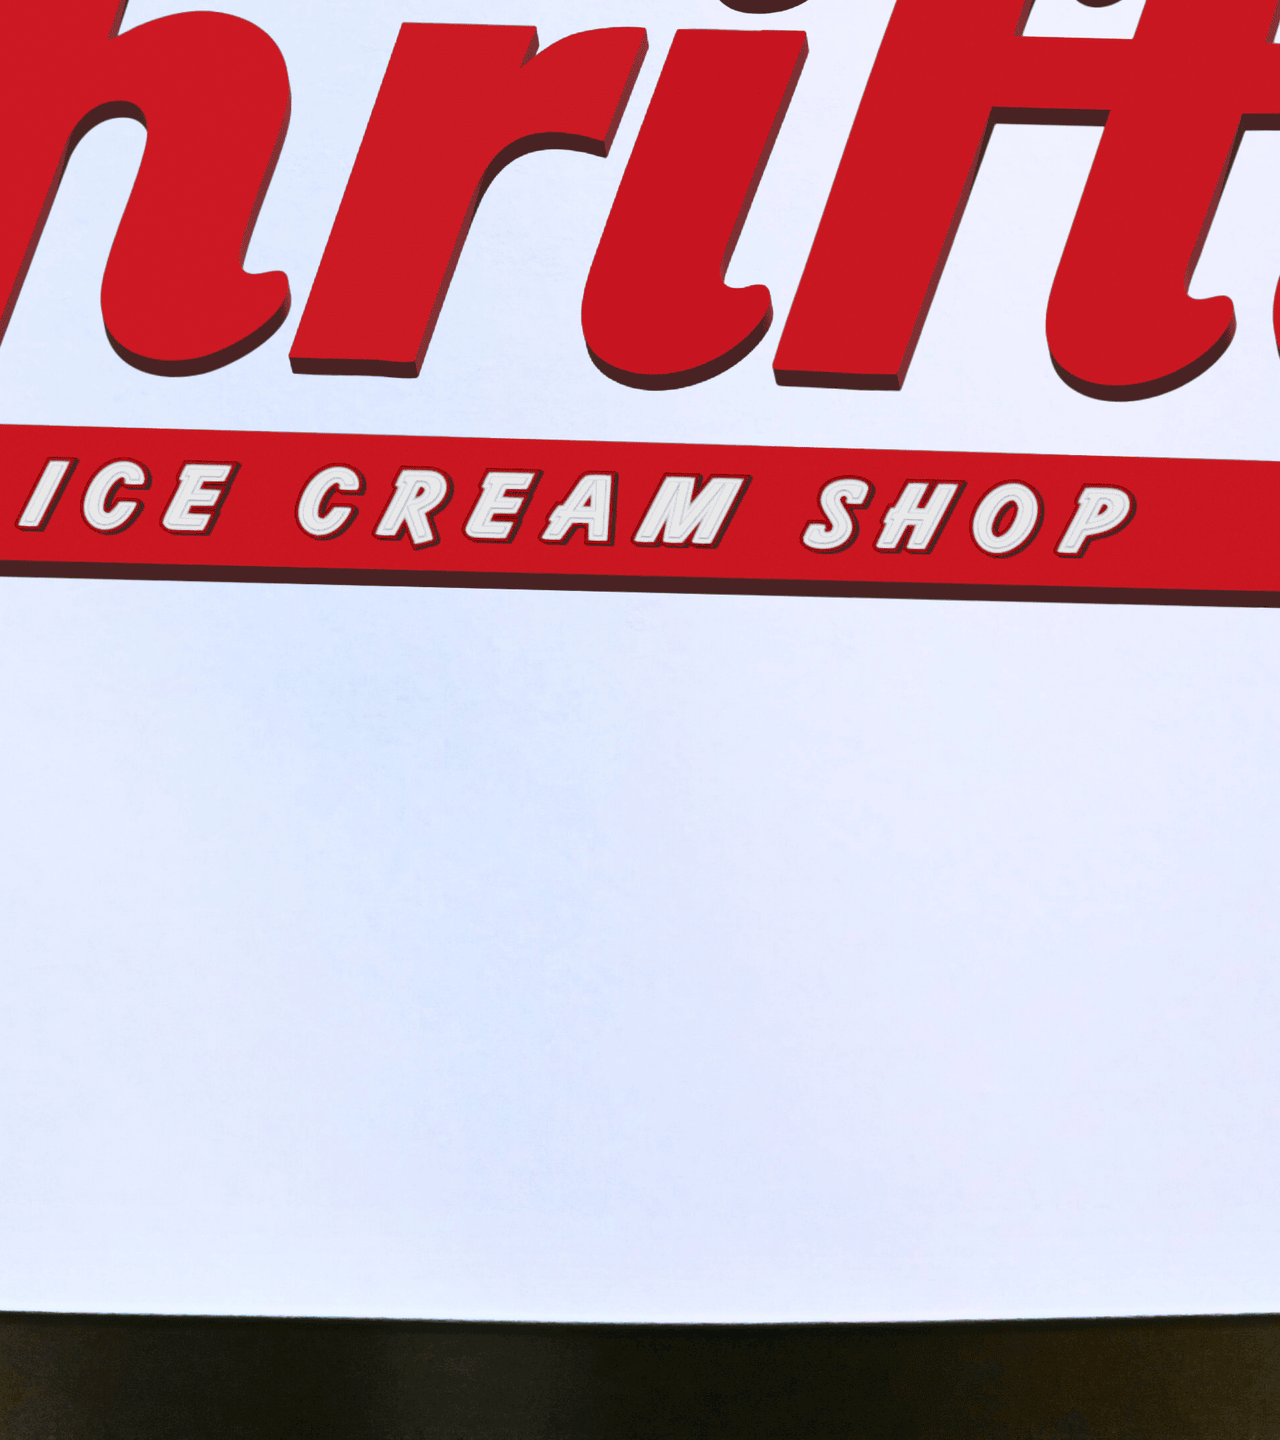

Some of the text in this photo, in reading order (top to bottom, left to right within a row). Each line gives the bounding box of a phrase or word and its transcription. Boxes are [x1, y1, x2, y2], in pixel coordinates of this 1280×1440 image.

[18, 456, 1136, 559] ICE CREAM SHOP
